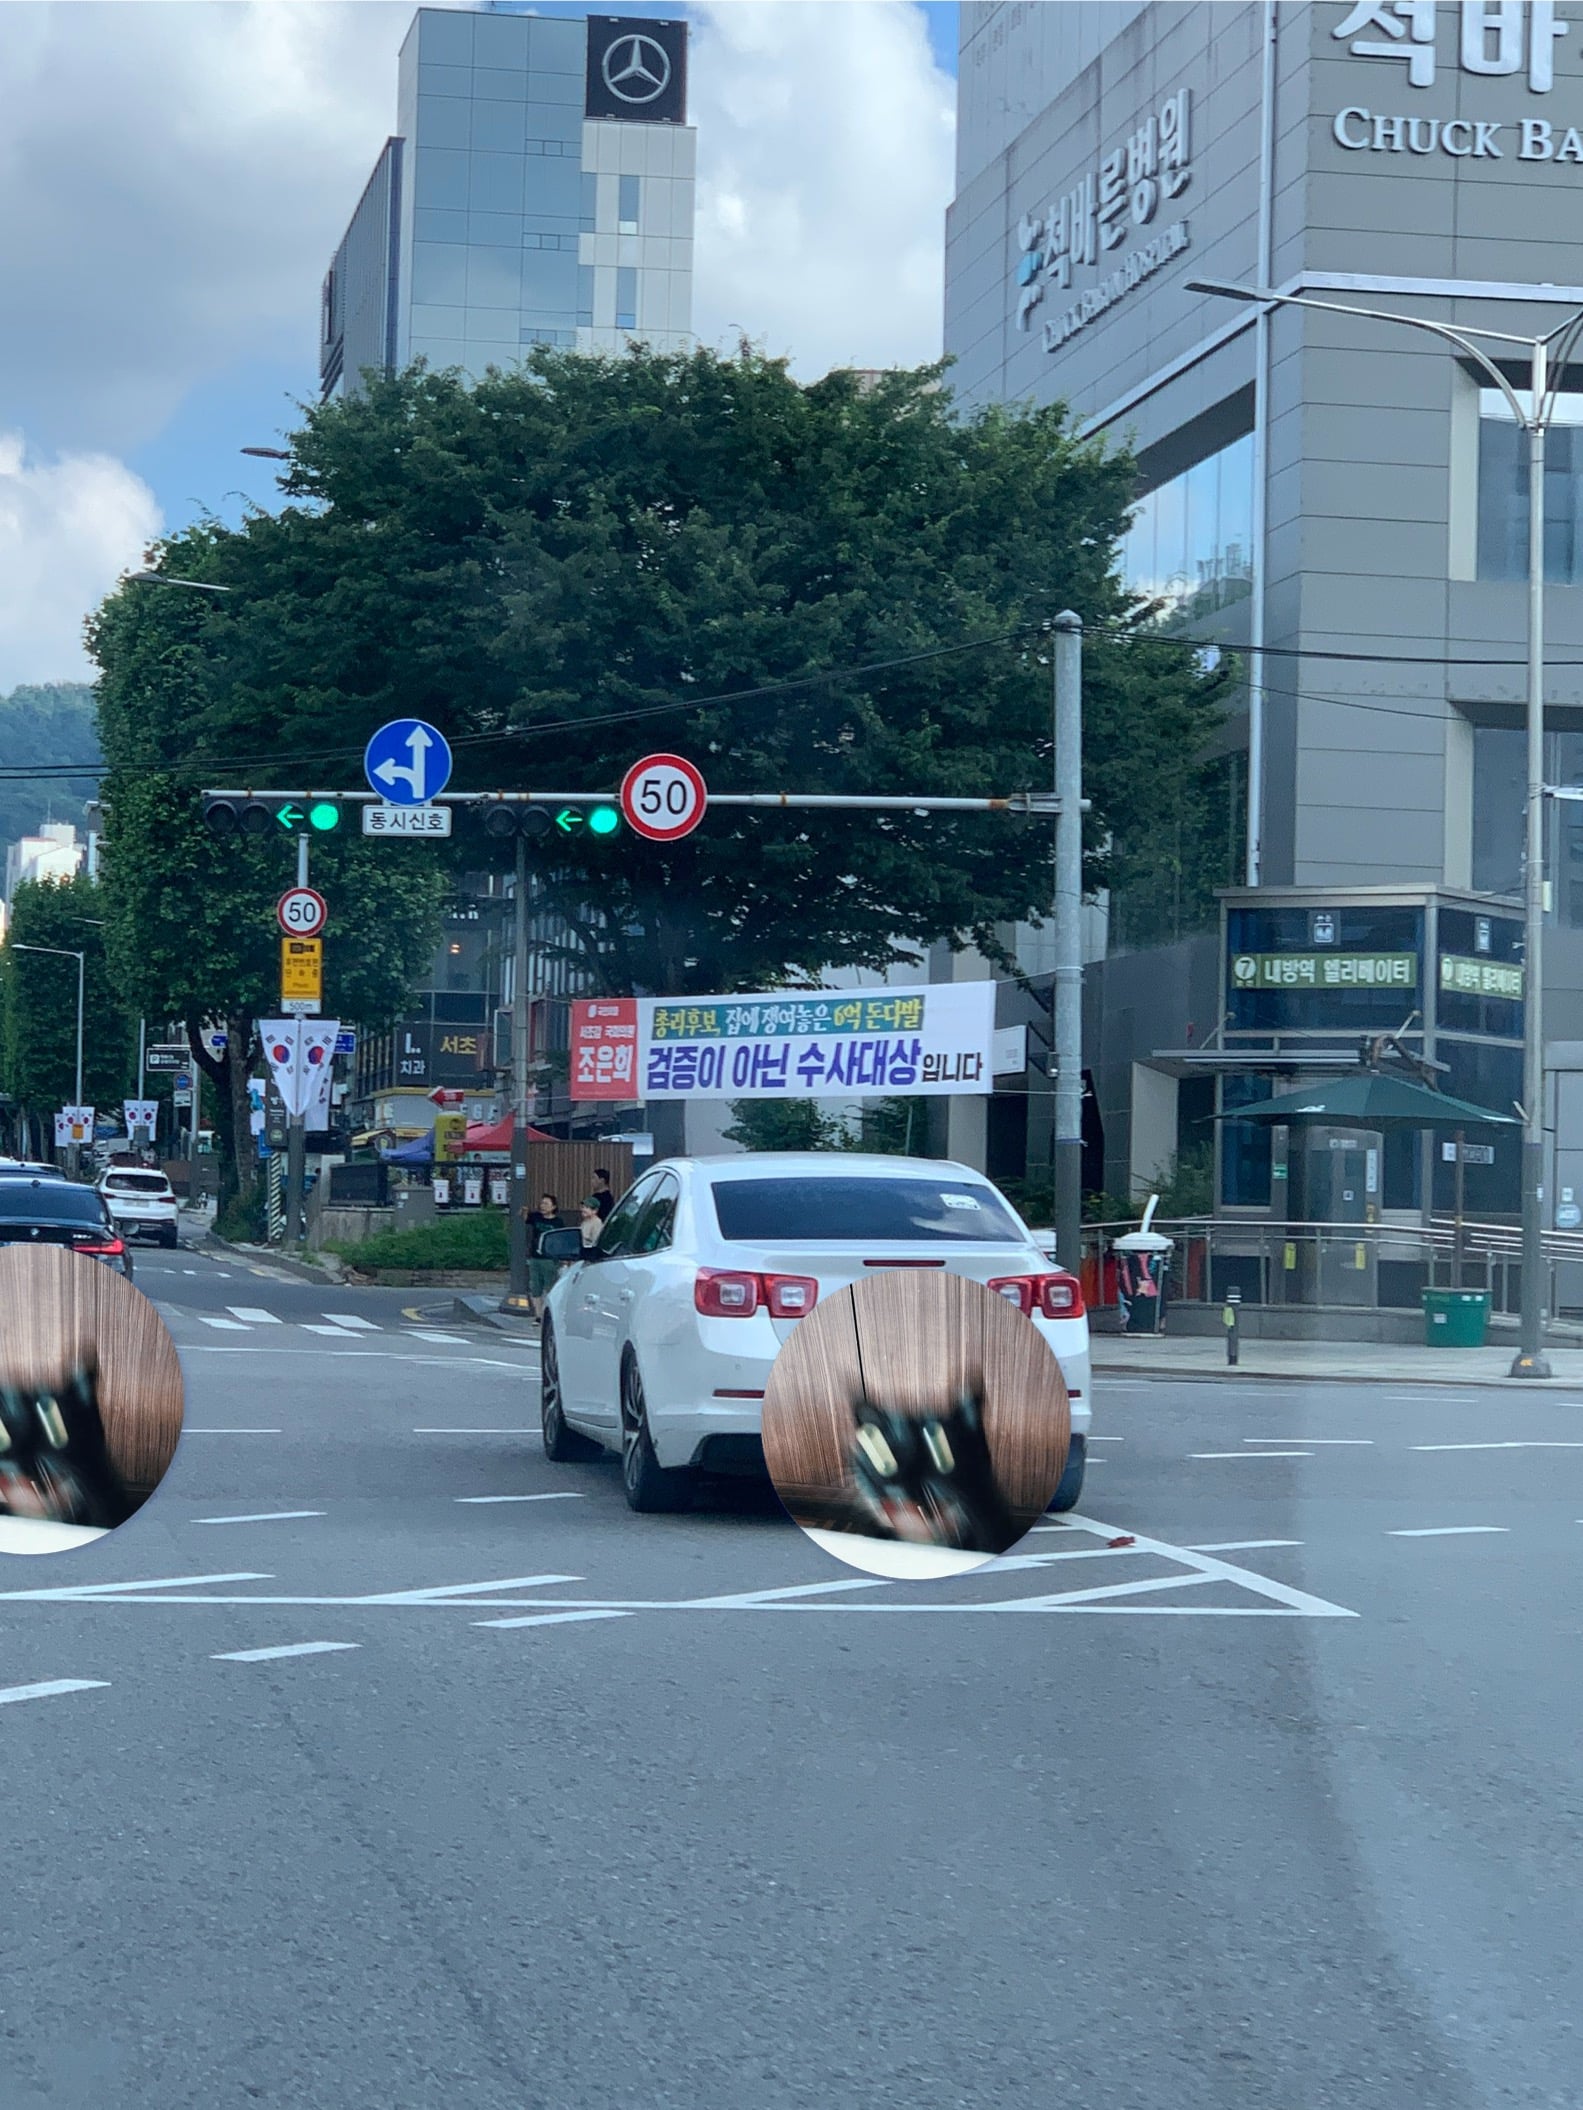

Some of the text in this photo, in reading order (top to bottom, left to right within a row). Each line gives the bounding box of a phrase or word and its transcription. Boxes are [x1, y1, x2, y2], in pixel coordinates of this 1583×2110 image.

[1333, 106, 1504, 158] CHUCK
[641, 780, 688, 814] 50
[369, 812, 445, 831] 동시신호
[288, 902, 316, 922] 50
[1264, 959, 1316, 983] 내방역
[653, 998, 923, 1038] 총리후보, 집에 쟁여놓은 6억 돈다발
[440, 1036, 477, 1055] 서초
[399, 1060, 426, 1075] 치과
[577, 1044, 634, 1083] 조은희
[646, 1045, 727, 1090] 검증이
[732, 1043, 790, 1088] 아닌
